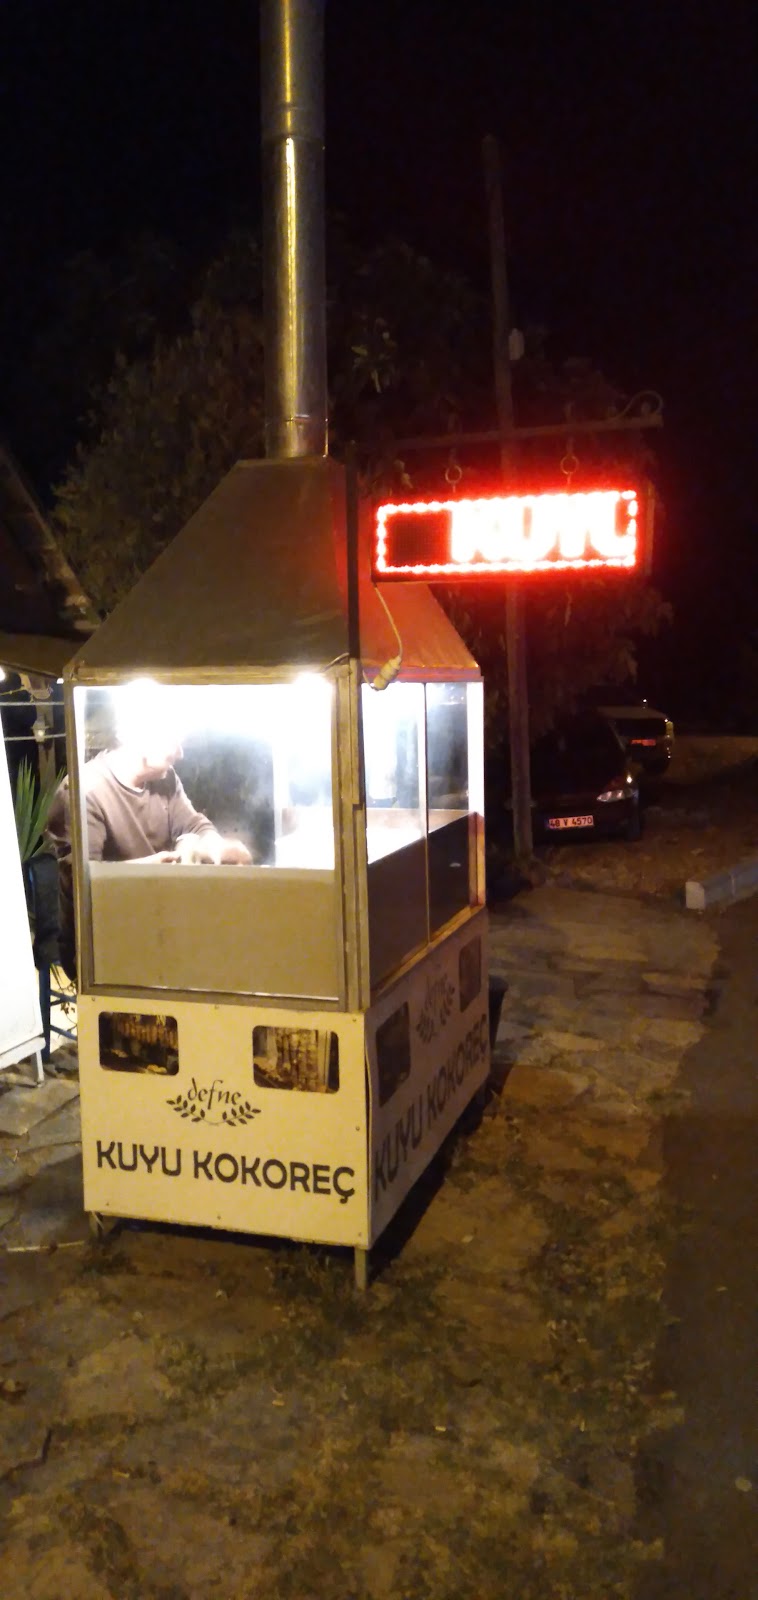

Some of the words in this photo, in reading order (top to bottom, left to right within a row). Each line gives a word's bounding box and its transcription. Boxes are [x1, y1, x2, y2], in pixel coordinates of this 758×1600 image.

[563, 818, 569, 827] V
[571, 816, 593, 826] 4570
[187, 1077, 242, 1110] defne
[374, 1094, 423, 1200] KUYU
[96, 1140, 182, 1177] KUYU
[193, 1150, 355, 1204] KOKOREÇ
